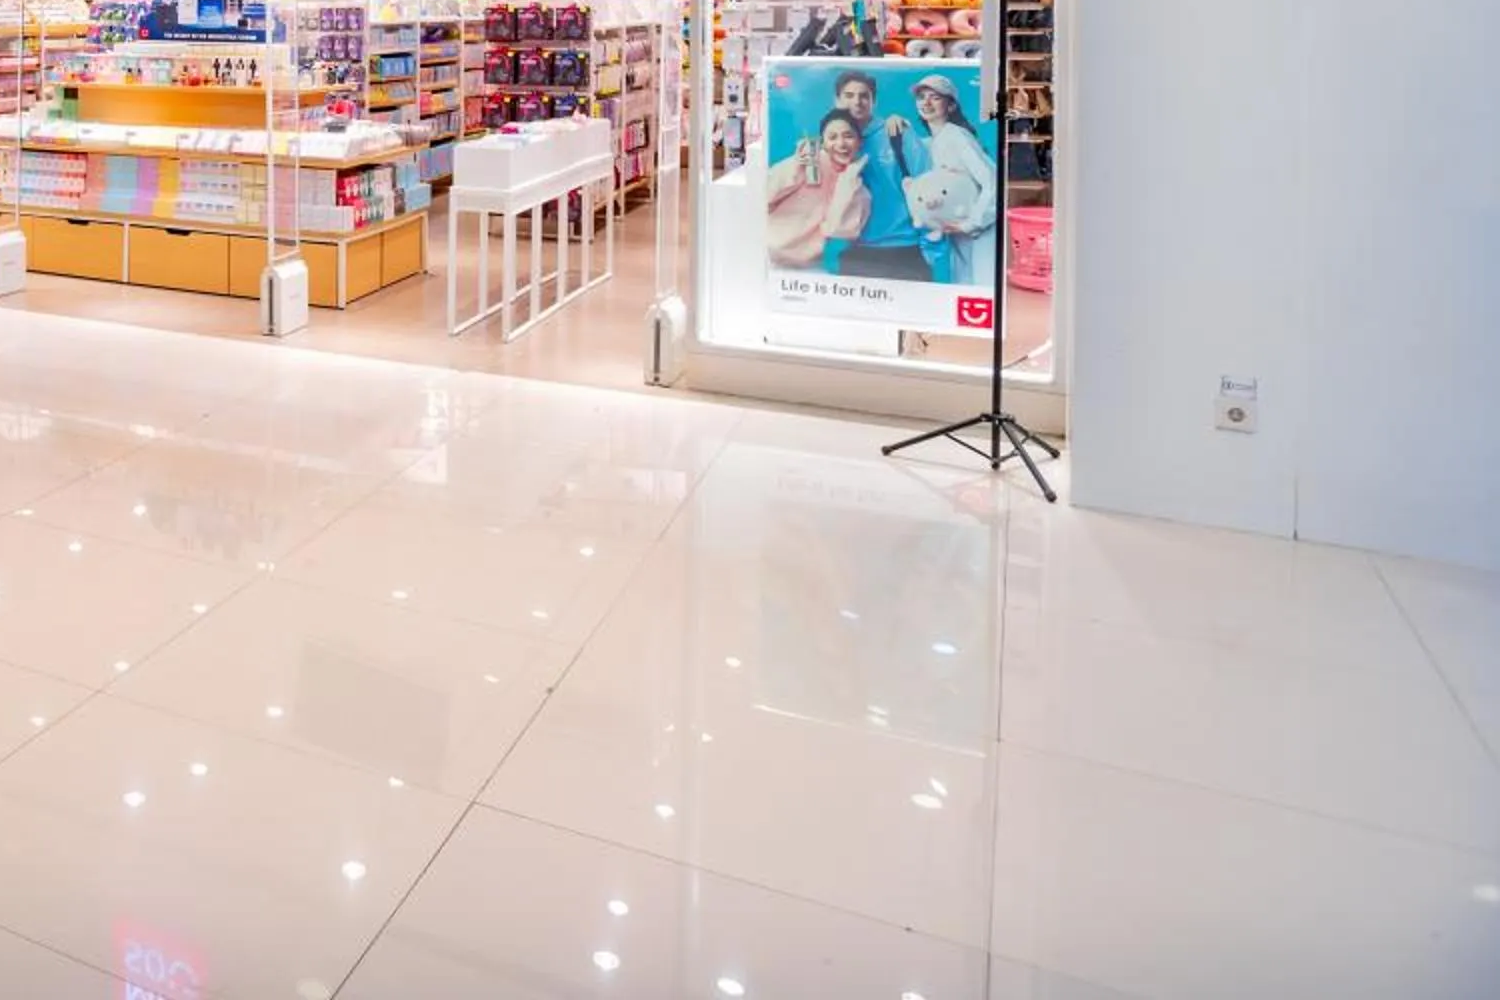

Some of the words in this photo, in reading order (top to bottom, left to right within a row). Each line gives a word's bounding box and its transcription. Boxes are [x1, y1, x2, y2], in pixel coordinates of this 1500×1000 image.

[781, 279, 810, 293] Life
[815, 282, 828, 294] is
[833, 283, 855, 297] for
